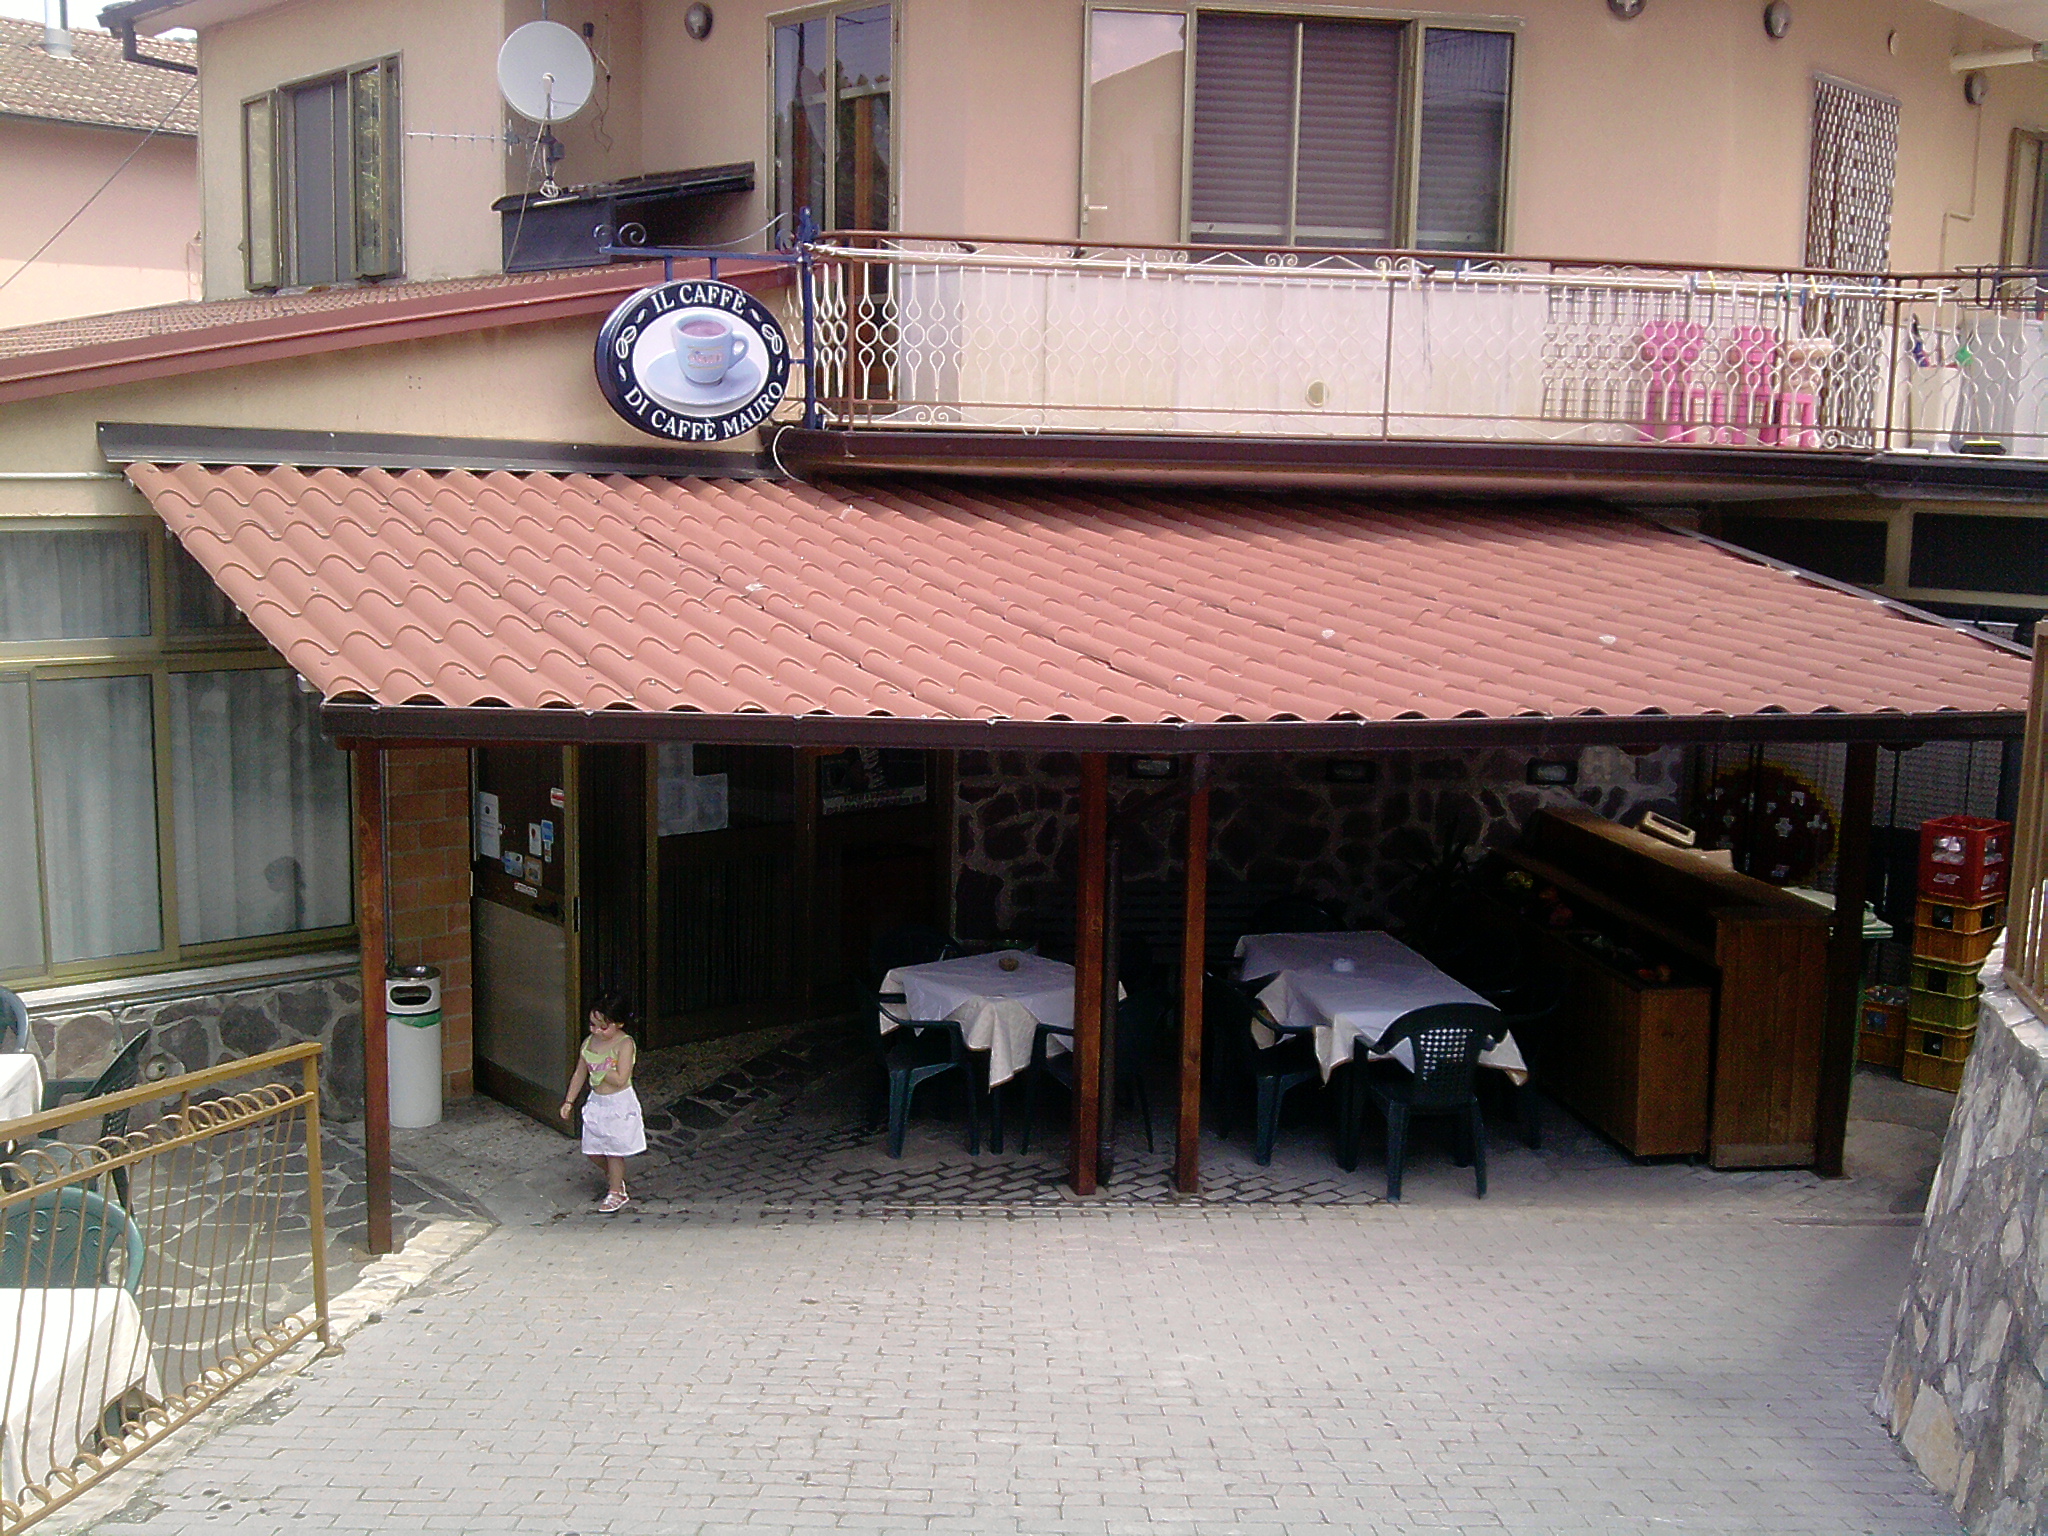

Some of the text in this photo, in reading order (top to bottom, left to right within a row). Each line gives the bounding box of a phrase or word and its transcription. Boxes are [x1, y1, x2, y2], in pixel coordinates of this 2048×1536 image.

[651, 284, 747, 315] IL CAFFÈ
[624, 382, 784, 441] DI CAFFÈ MAURO
